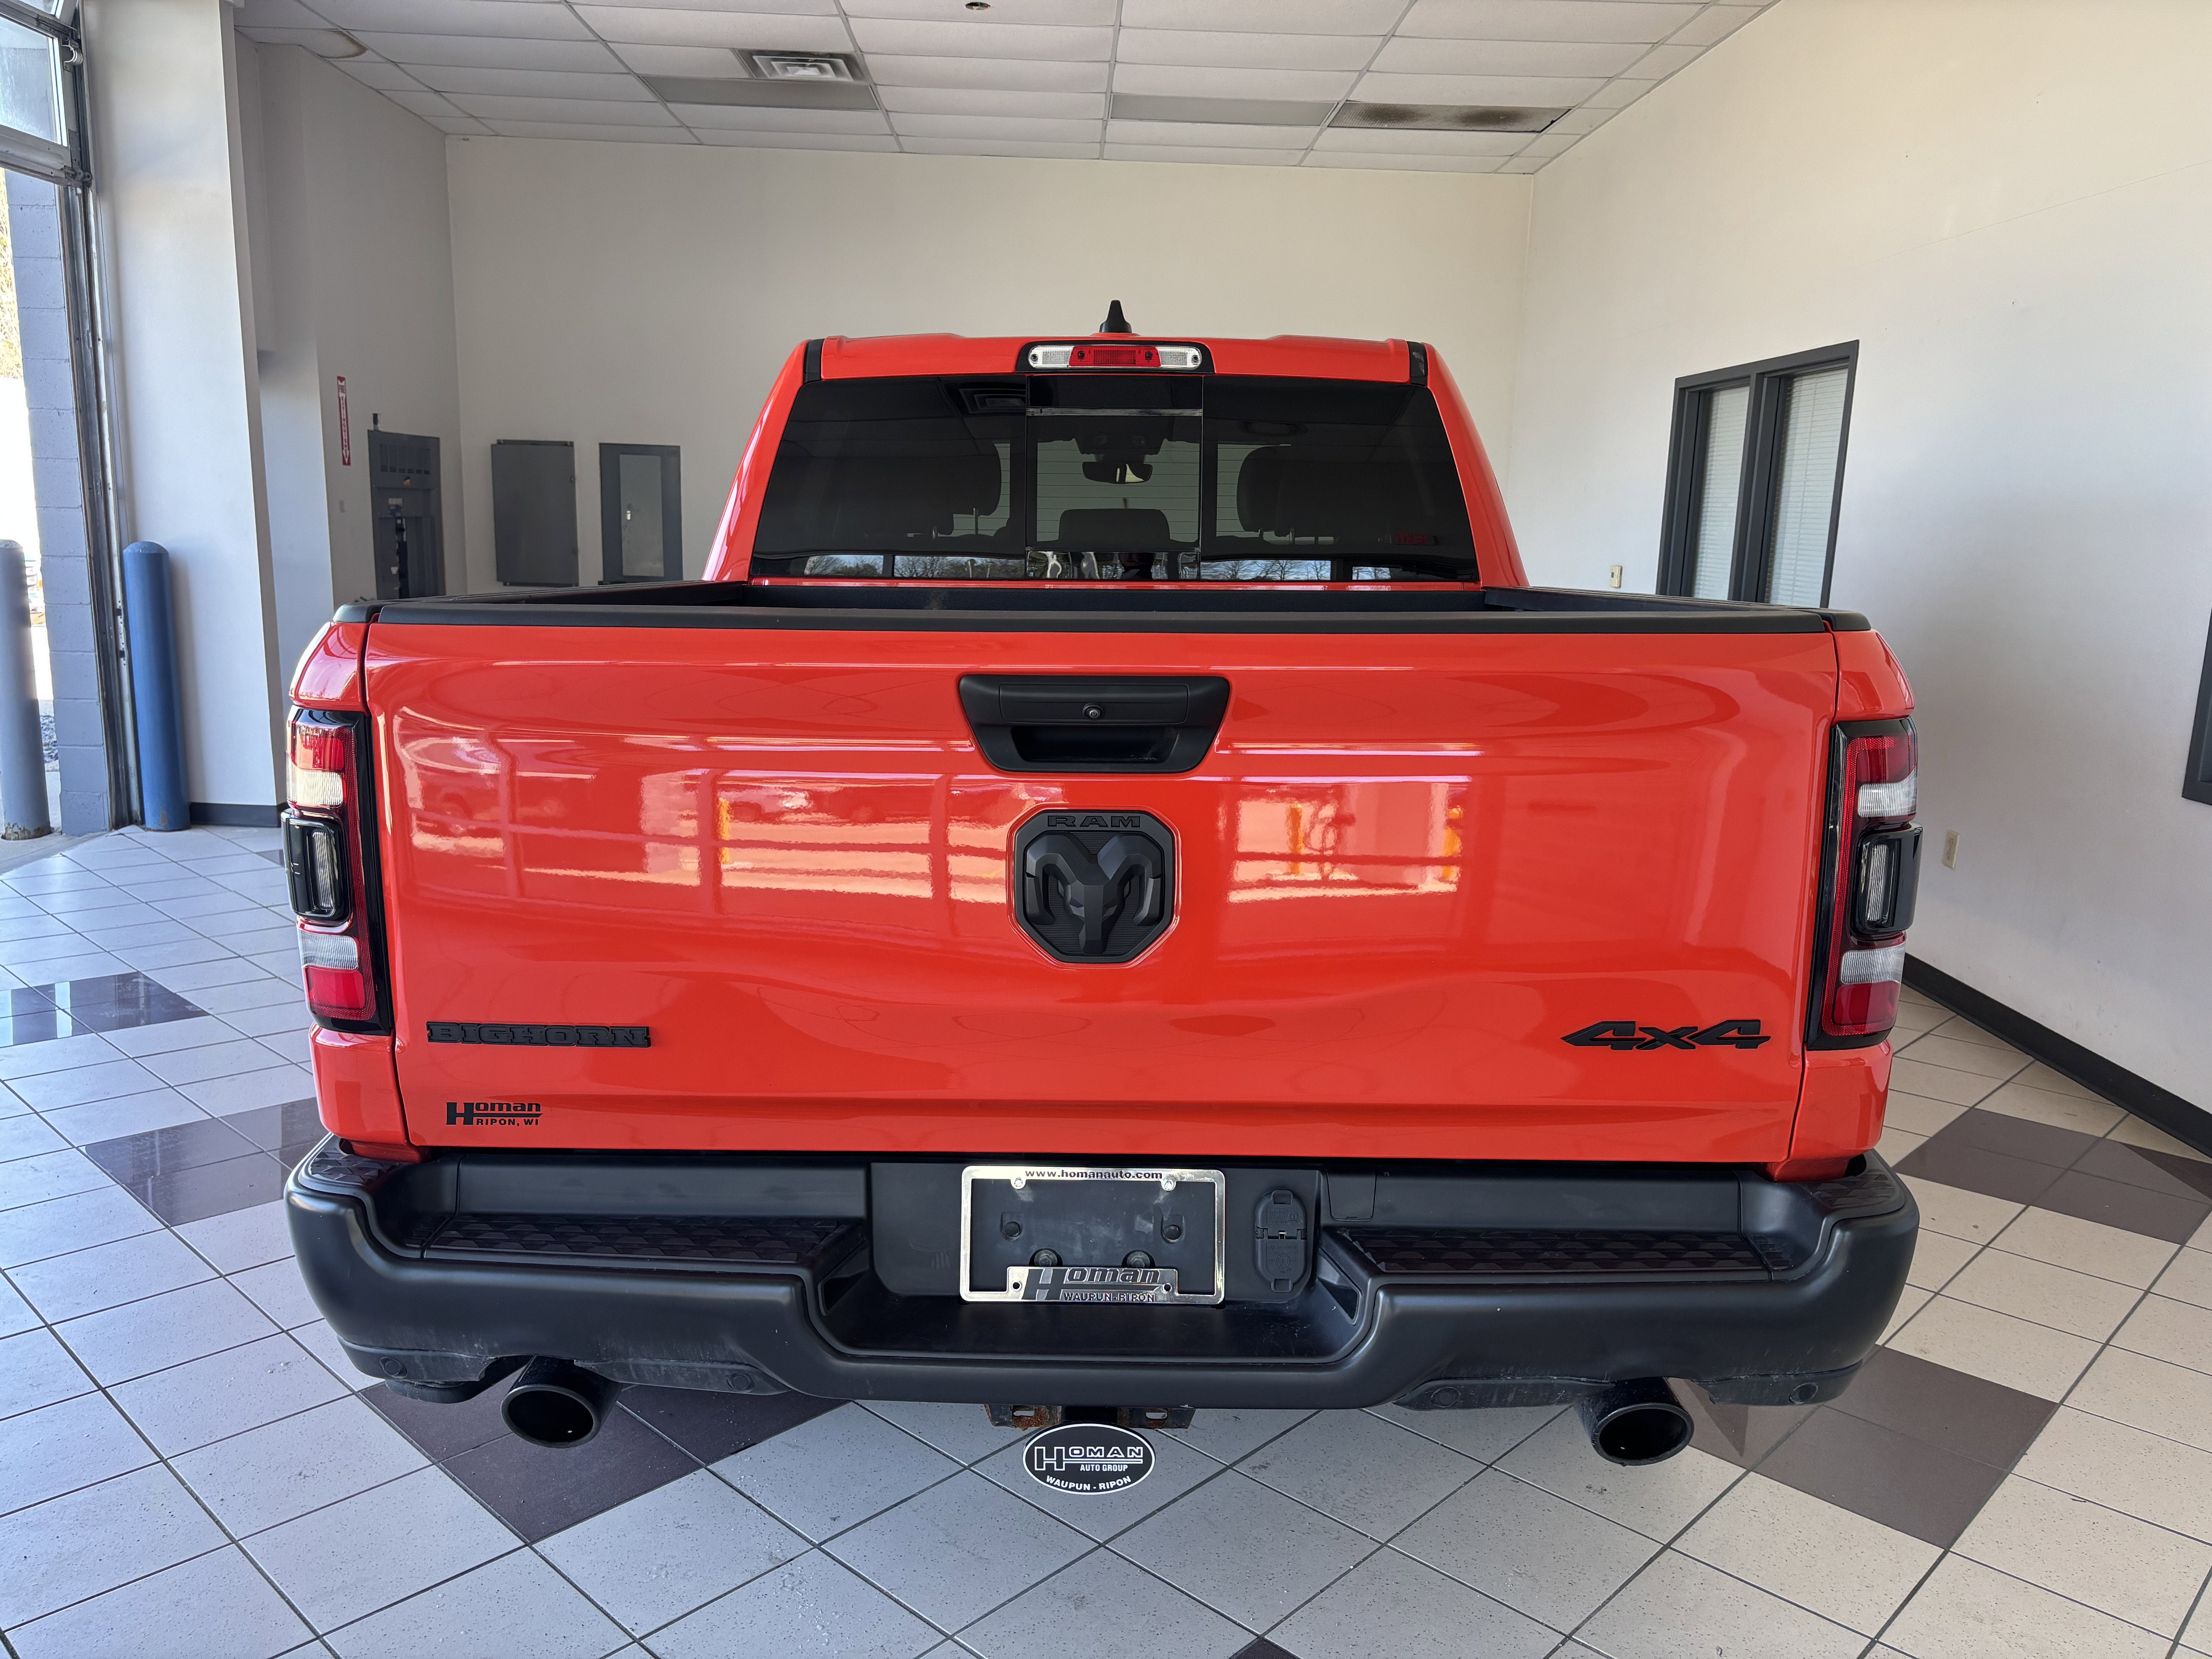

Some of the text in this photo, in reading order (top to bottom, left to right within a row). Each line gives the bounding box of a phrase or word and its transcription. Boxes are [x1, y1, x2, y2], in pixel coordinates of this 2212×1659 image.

[1048, 815, 1140, 828] RAM
[426, 1022, 651, 1048] BIGHORN
[1561, 1019, 1771, 1050] 4x4
[446, 1102, 541, 1125] Homan
[476, 1118, 520, 1127] RIPON,
[1025, 1170, 1163, 1180] www.homanauto.com
[1022, 1268, 1161, 1300] Homan
[1034, 1446, 1143, 1471] HOMAN
[1046, 1475, 1091, 1491] WAUPUN
[1099, 1475, 1131, 1490] RIPON
